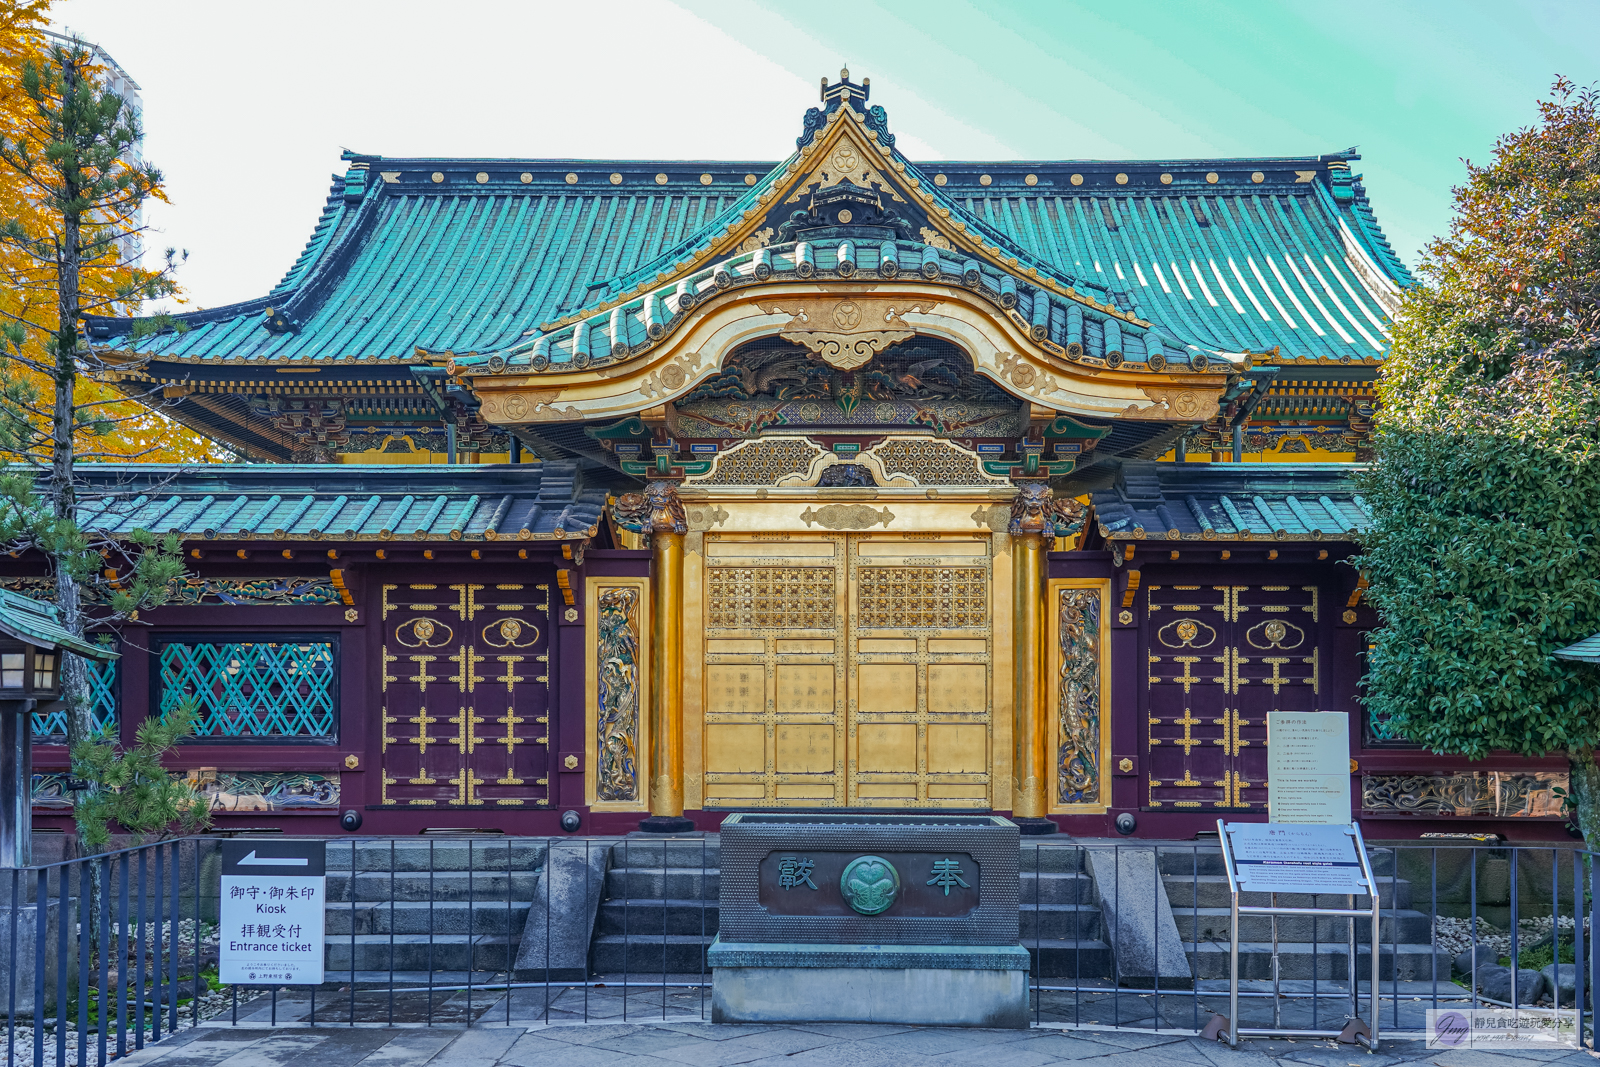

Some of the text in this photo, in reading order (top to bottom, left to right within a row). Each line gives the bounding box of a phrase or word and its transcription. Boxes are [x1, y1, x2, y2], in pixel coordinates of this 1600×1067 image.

[926, 858, 971, 896] 奉
[230, 885, 314, 900] 御守・御朱印
[256, 904, 286, 913] Kiosk
[241, 924, 302, 938] 拝観受付
[230, 941, 312, 952] Entrance ticket
